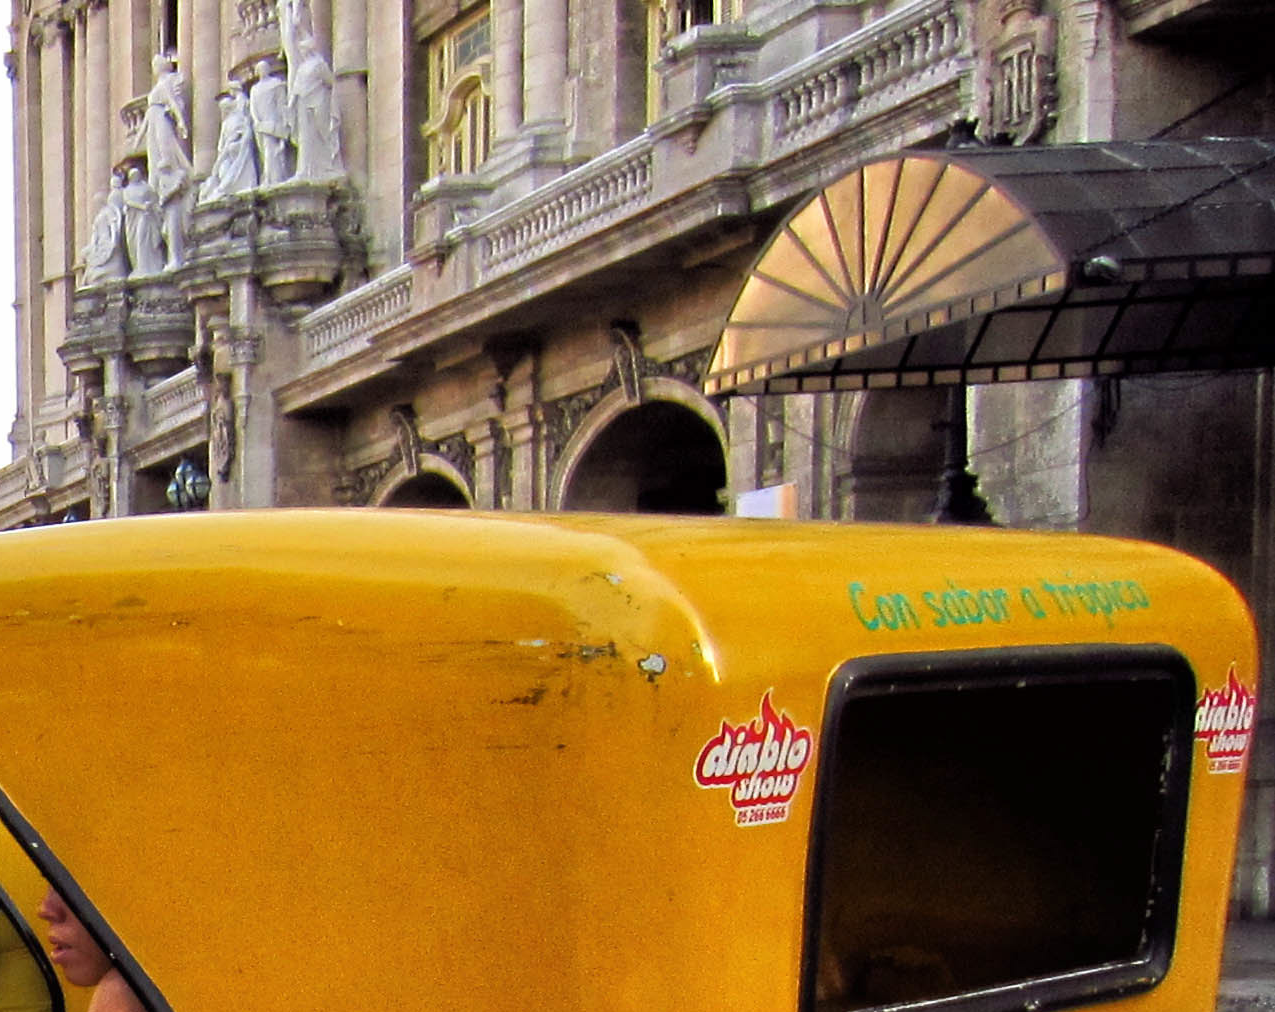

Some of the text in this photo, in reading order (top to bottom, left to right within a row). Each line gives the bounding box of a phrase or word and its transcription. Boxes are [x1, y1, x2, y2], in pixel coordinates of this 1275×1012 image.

[848, 582, 921, 630] Con
[922, 579, 1009, 627] sabor
[1021, 588, 1046, 618] a
[1193, 689, 1254, 732] diablo
[702, 721, 808, 778] diablo
[734, 771, 794, 801] show
